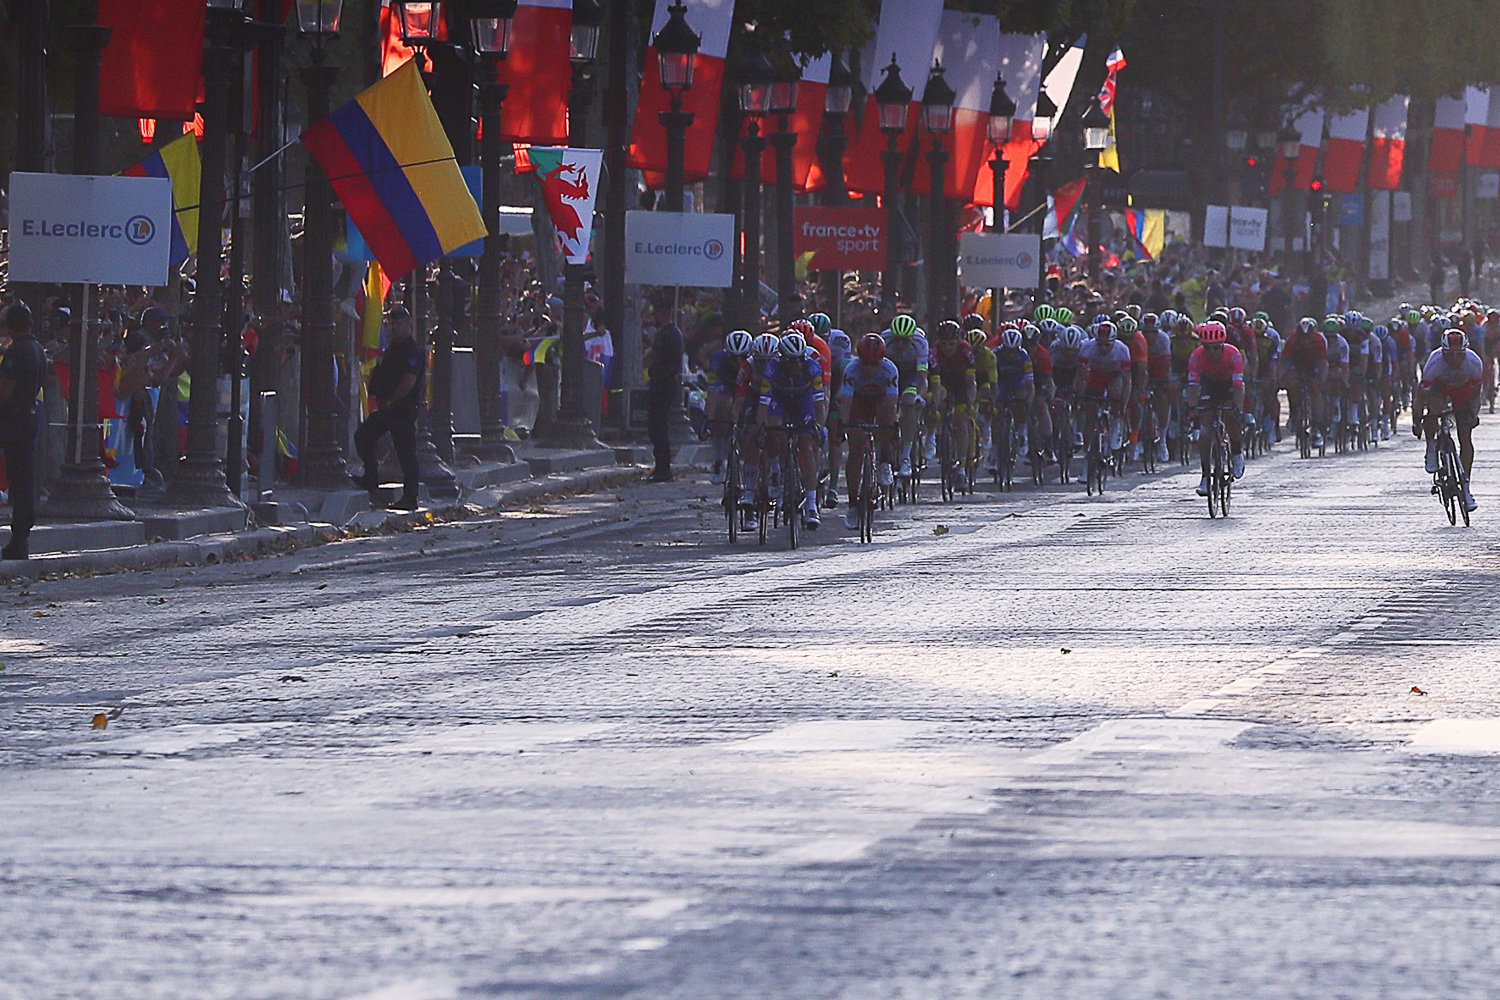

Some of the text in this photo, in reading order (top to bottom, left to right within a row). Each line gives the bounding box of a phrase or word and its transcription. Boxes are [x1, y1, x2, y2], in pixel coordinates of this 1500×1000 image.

[22, 219, 122, 239] E.Leclerc
[635, 242, 702, 256] E.Leclerc
[837, 239, 879, 255] sport
